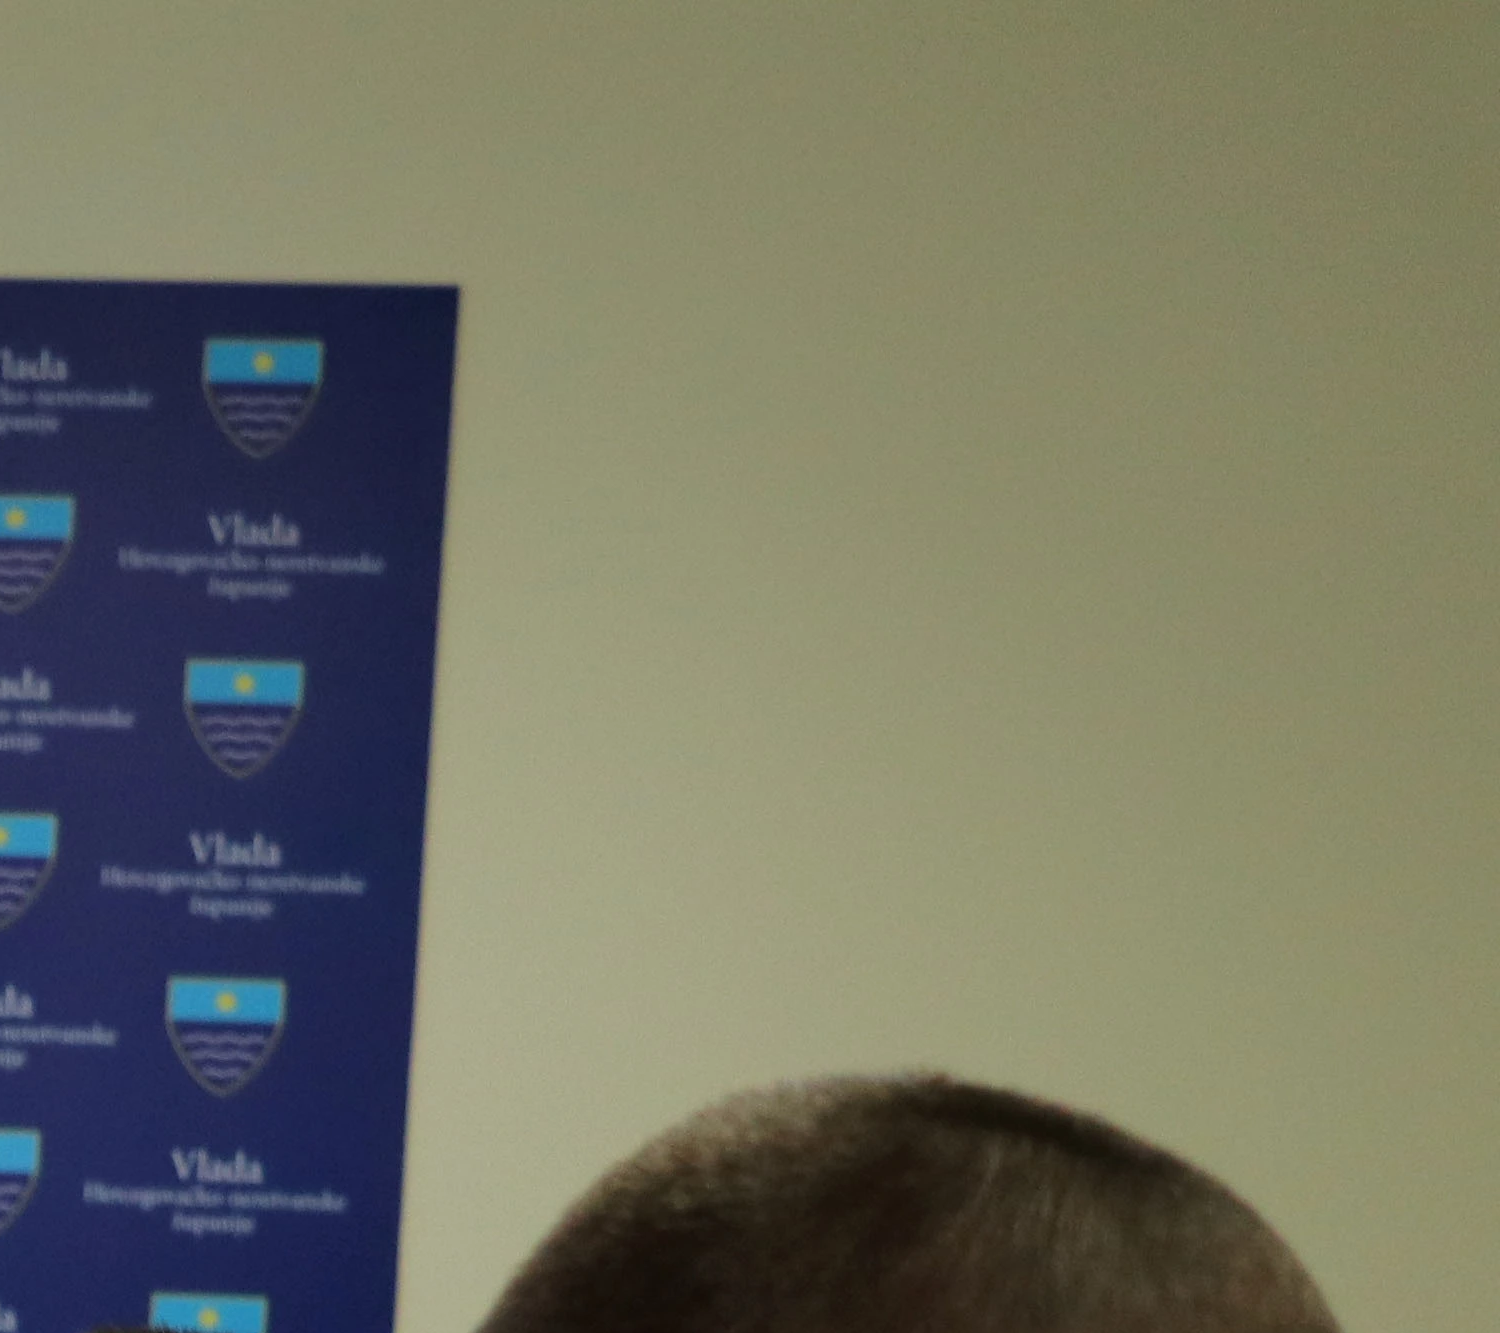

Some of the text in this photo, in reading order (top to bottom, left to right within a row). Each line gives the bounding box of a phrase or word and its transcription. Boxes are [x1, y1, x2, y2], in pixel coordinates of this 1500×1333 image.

[207, 512, 301, 548] Vlada
[188, 831, 282, 867] Vlada
[171, 1148, 264, 1184] Vlada
